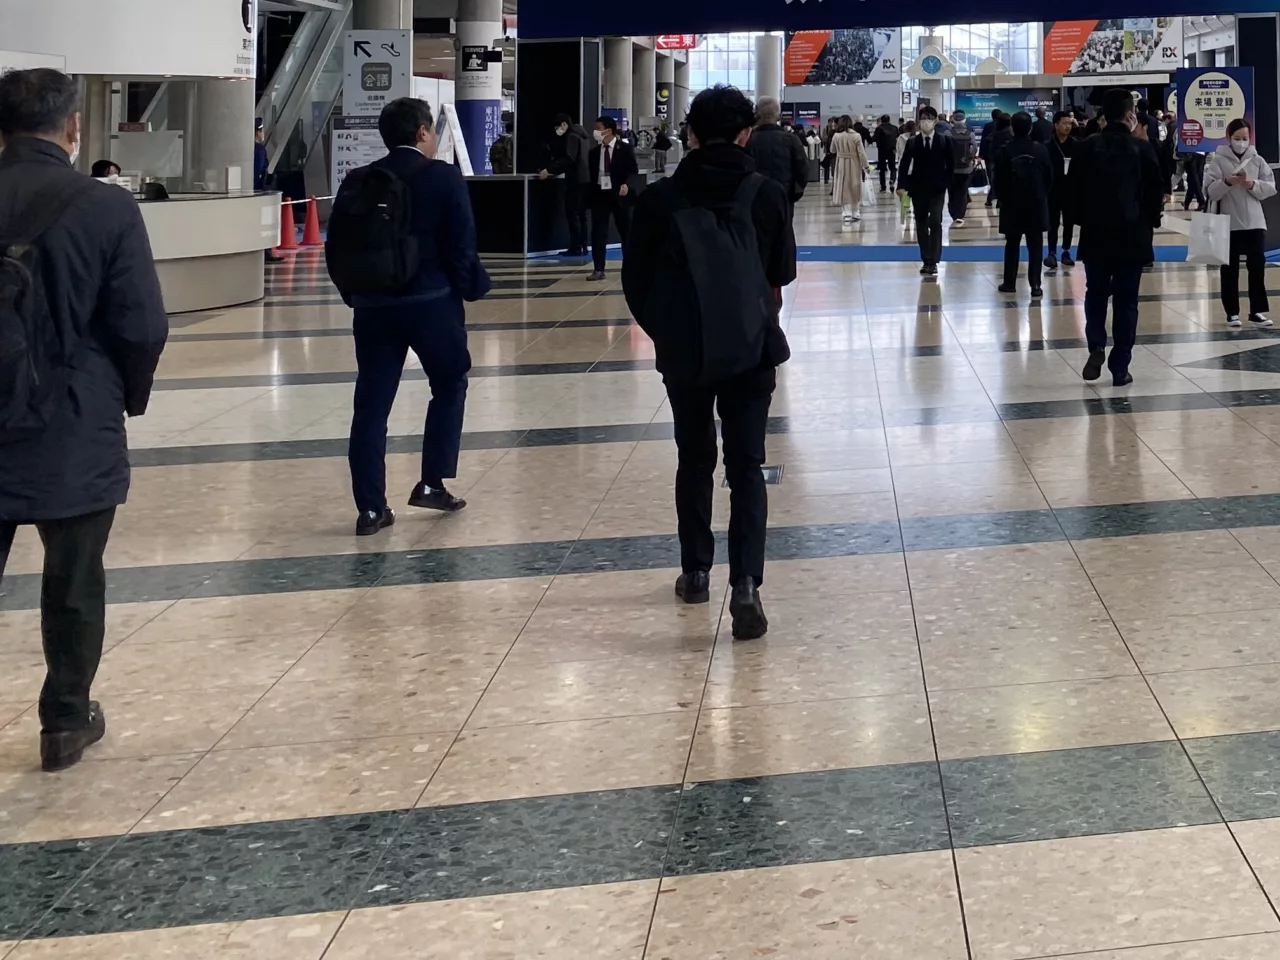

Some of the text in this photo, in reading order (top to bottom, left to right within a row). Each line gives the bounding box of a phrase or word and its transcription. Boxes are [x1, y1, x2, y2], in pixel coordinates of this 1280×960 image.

[682, 34, 695, 46] 東
[1162, 47, 1177, 58] RX
[882, 58, 896, 69] RX
